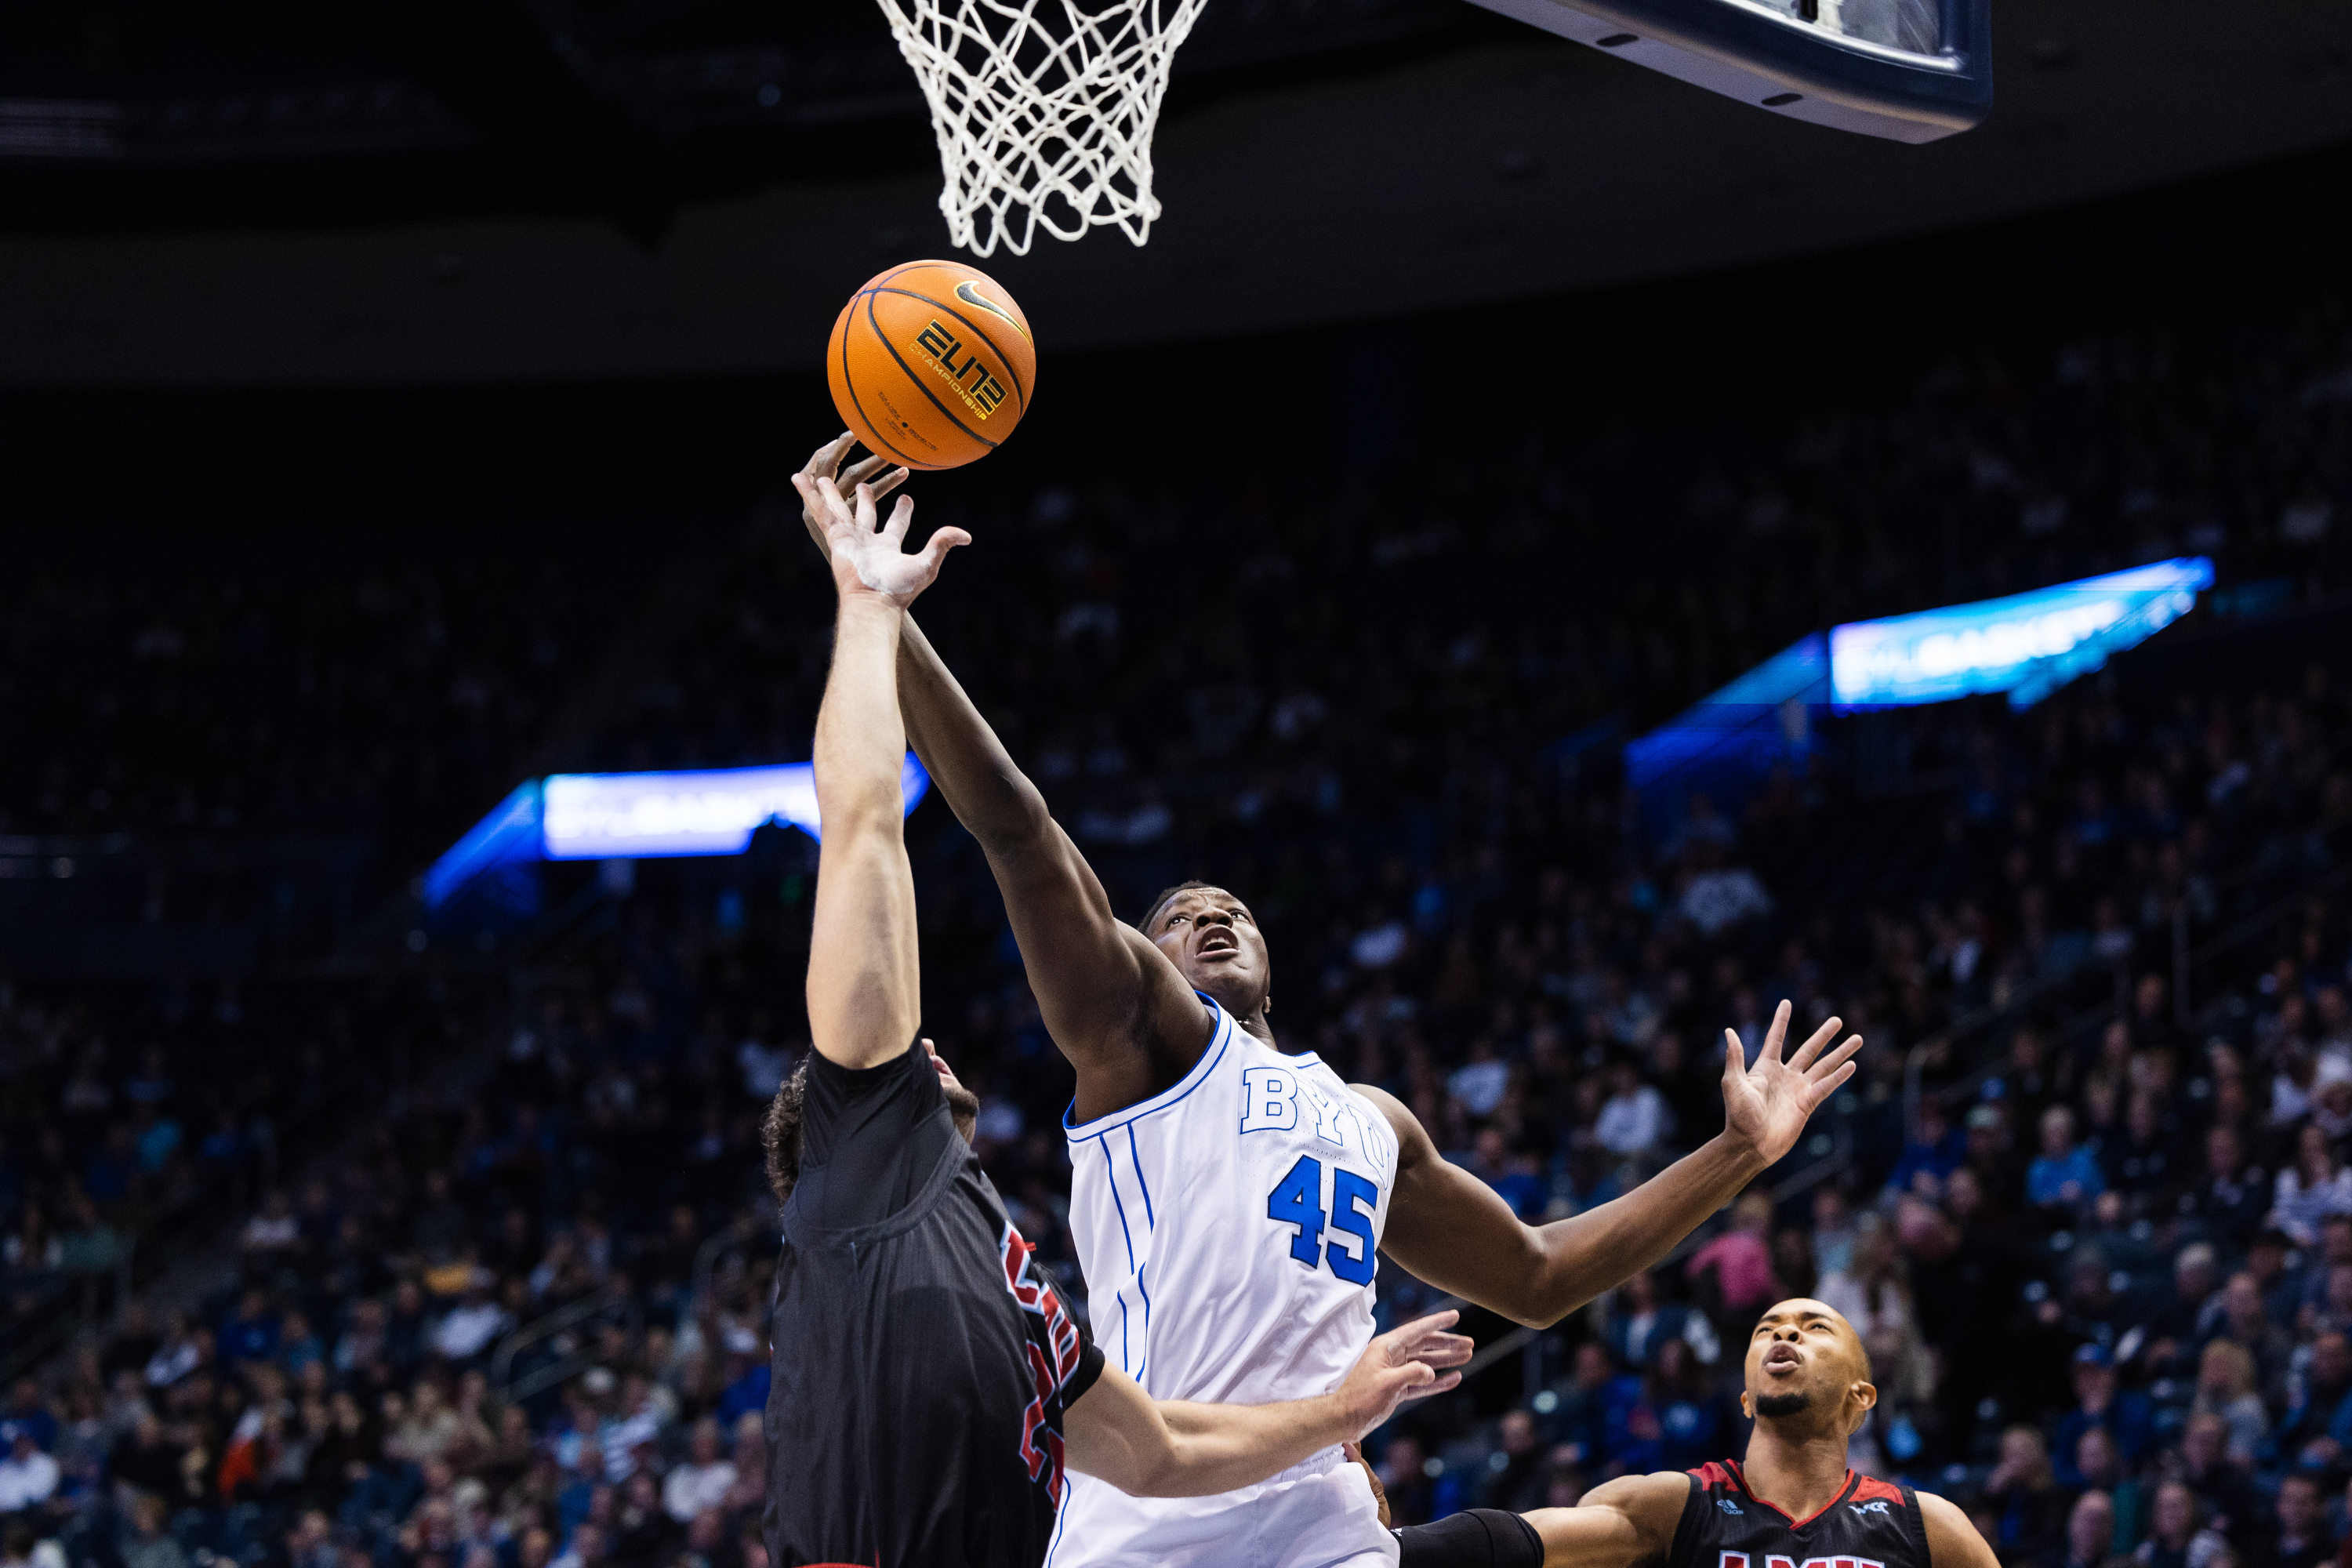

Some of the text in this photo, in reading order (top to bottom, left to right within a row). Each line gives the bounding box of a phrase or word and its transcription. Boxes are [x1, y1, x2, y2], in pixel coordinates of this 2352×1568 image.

[909, 343, 987, 420] CHAMPIONSHIP
[915, 319, 1008, 416] ELITE
[1240, 1067, 1390, 1190] BYU
[1268, 1154, 1378, 1287] 45
